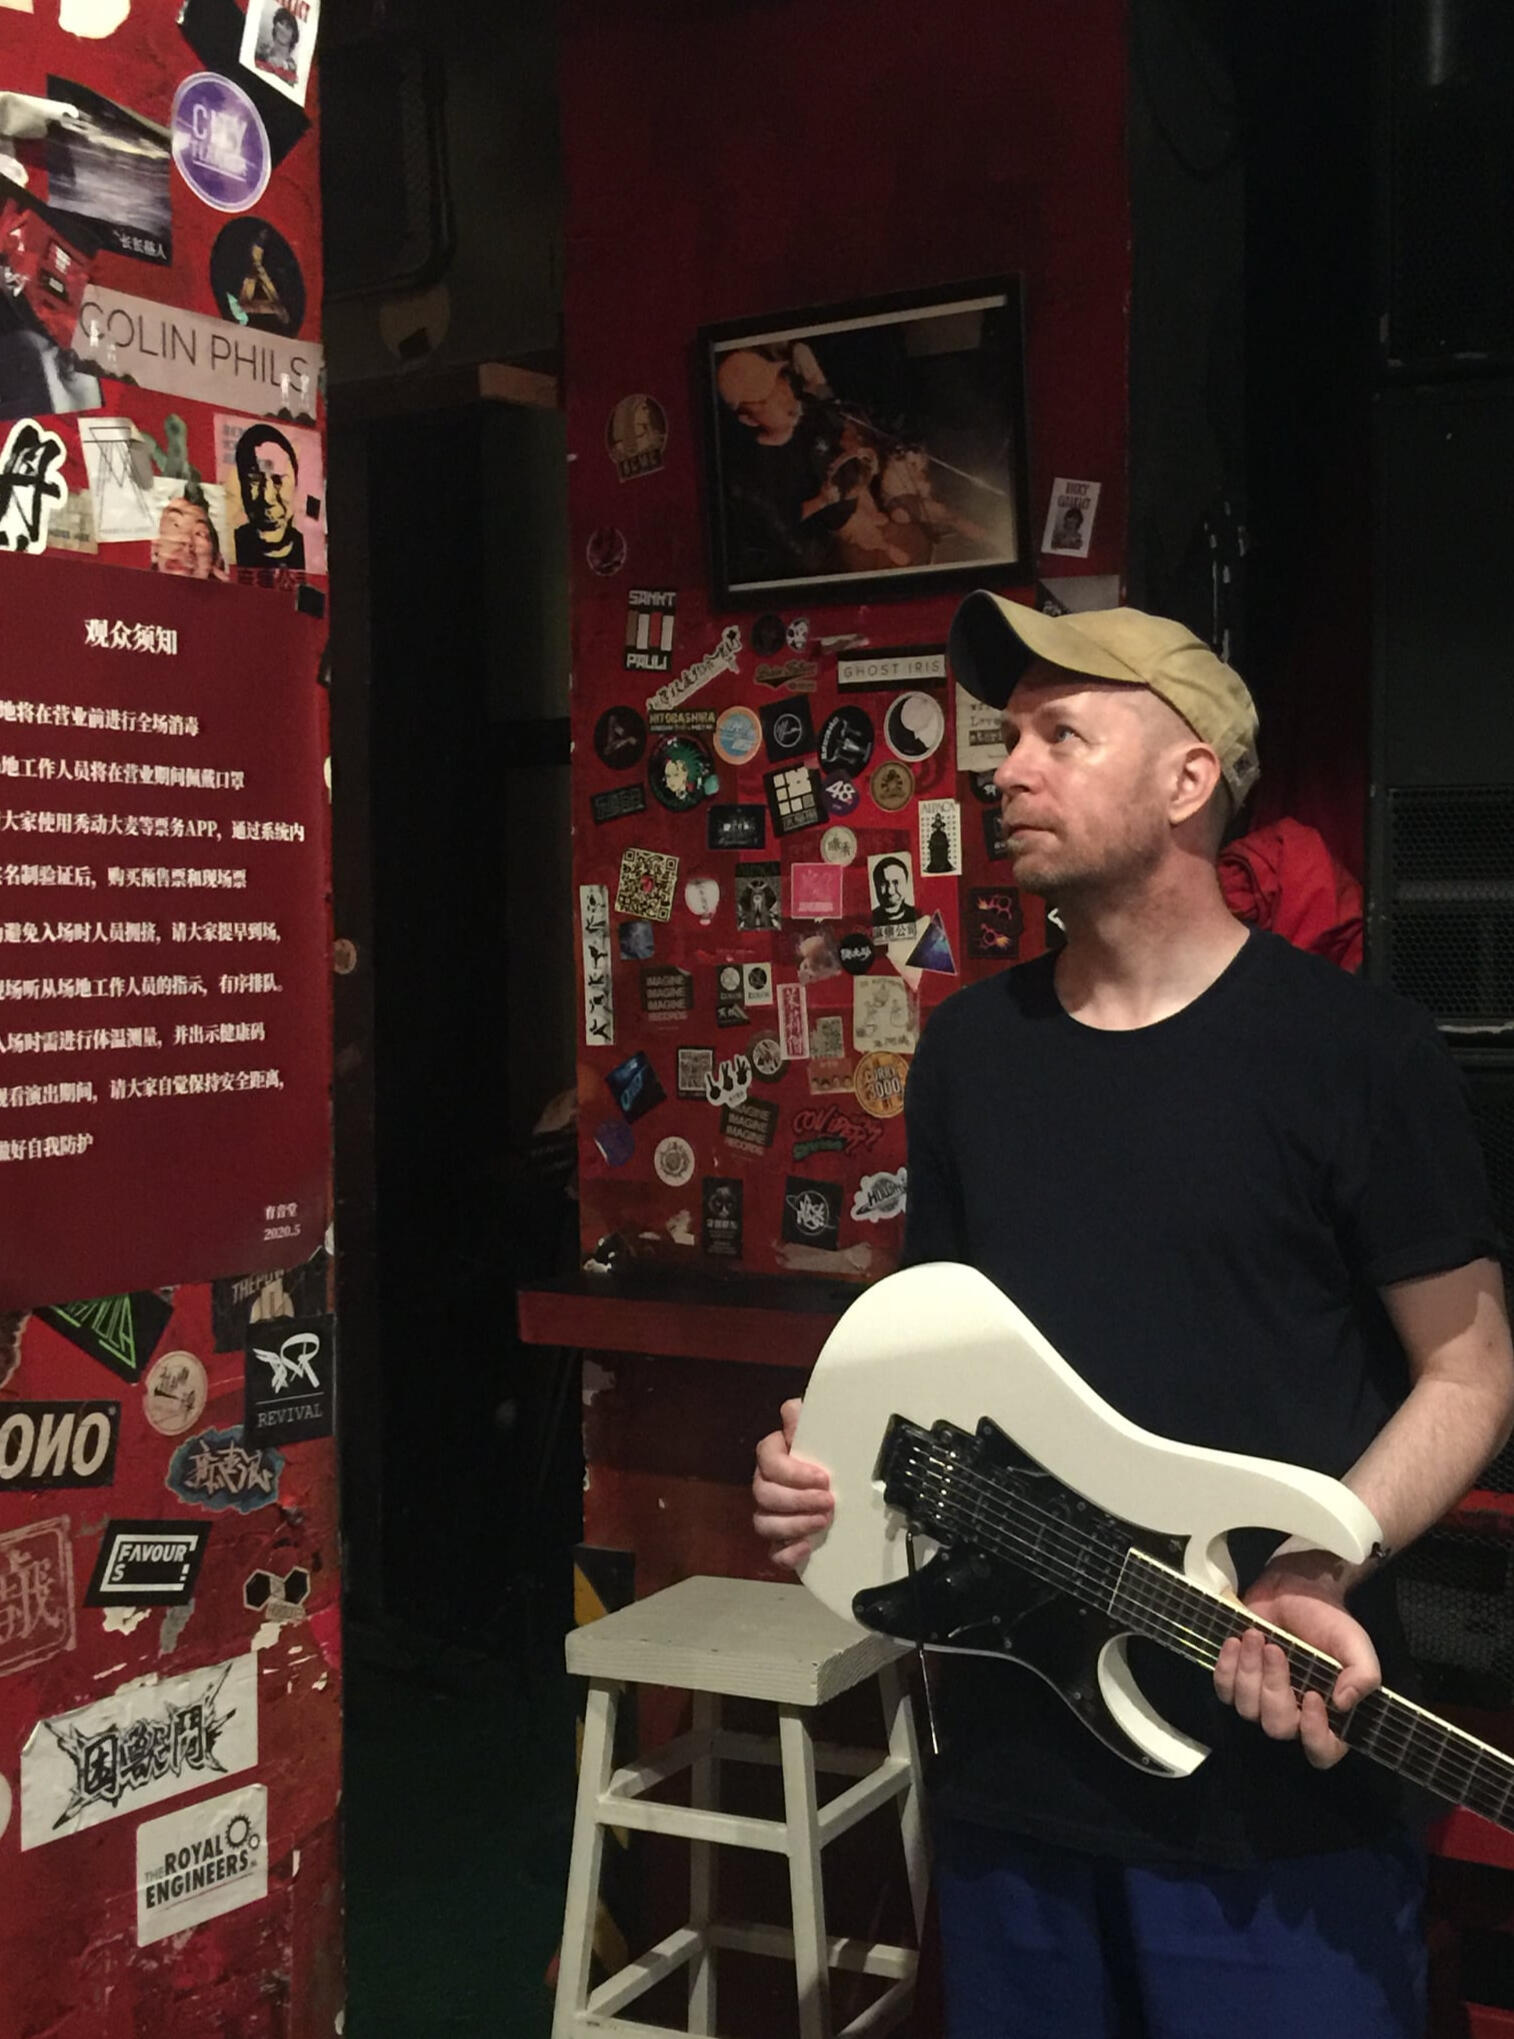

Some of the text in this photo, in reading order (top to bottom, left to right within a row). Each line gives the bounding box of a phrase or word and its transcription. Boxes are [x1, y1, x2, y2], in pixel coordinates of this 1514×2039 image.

[80, 302, 309, 393] COLIN PHILS
[84, 618, 178, 656] 观众须知
[626, 653, 668, 670] PAULI
[844, 660, 941, 678] GHOST IRIS
[0, 864, 247, 890] 名制验证后，购买预售票和现场票
[257, 1404, 323, 1429] REVIVAL
[118, 1544, 187, 1563] FAVOUR
[144, 1834, 223, 1884] THE ROYAL
[146, 1849, 250, 1910] ENGINEERS
